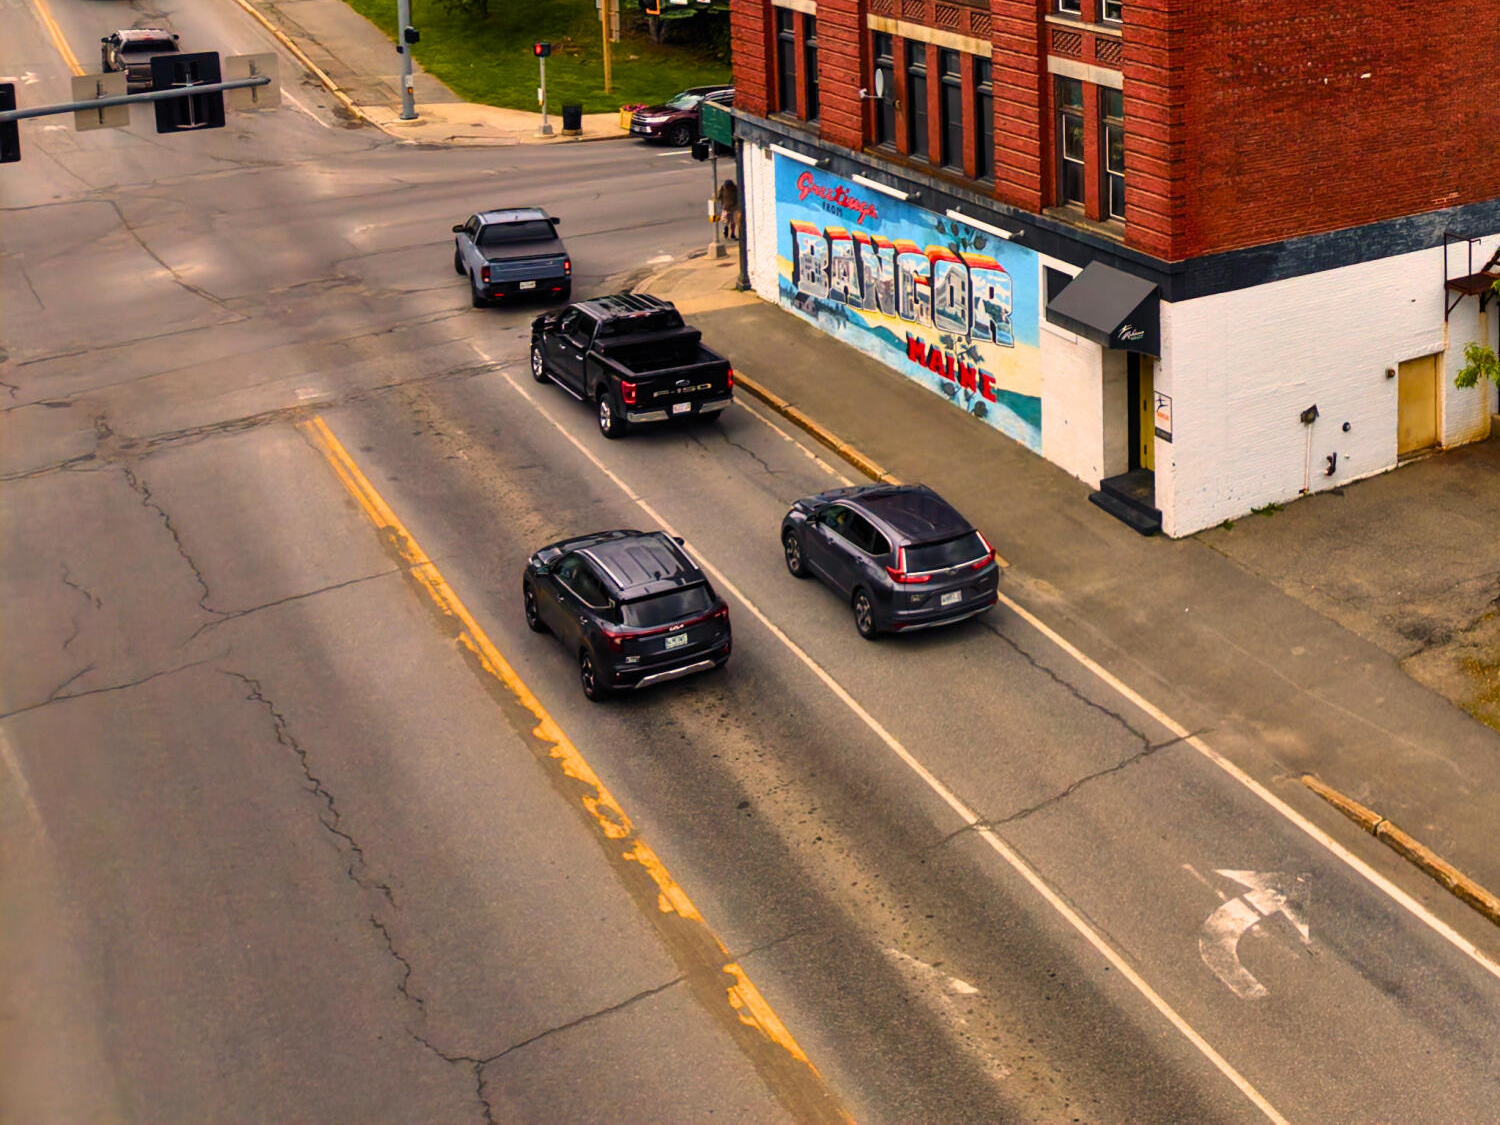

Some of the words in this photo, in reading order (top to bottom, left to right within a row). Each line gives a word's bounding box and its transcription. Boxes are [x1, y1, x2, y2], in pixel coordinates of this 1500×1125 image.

[797, 171, 878, 225] Greetings
[822, 201, 842, 217] FROM
[790, 219, 1014, 348] BANGOR
[653, 383, 712, 398] F-150
[906, 331, 997, 403] MAINE
